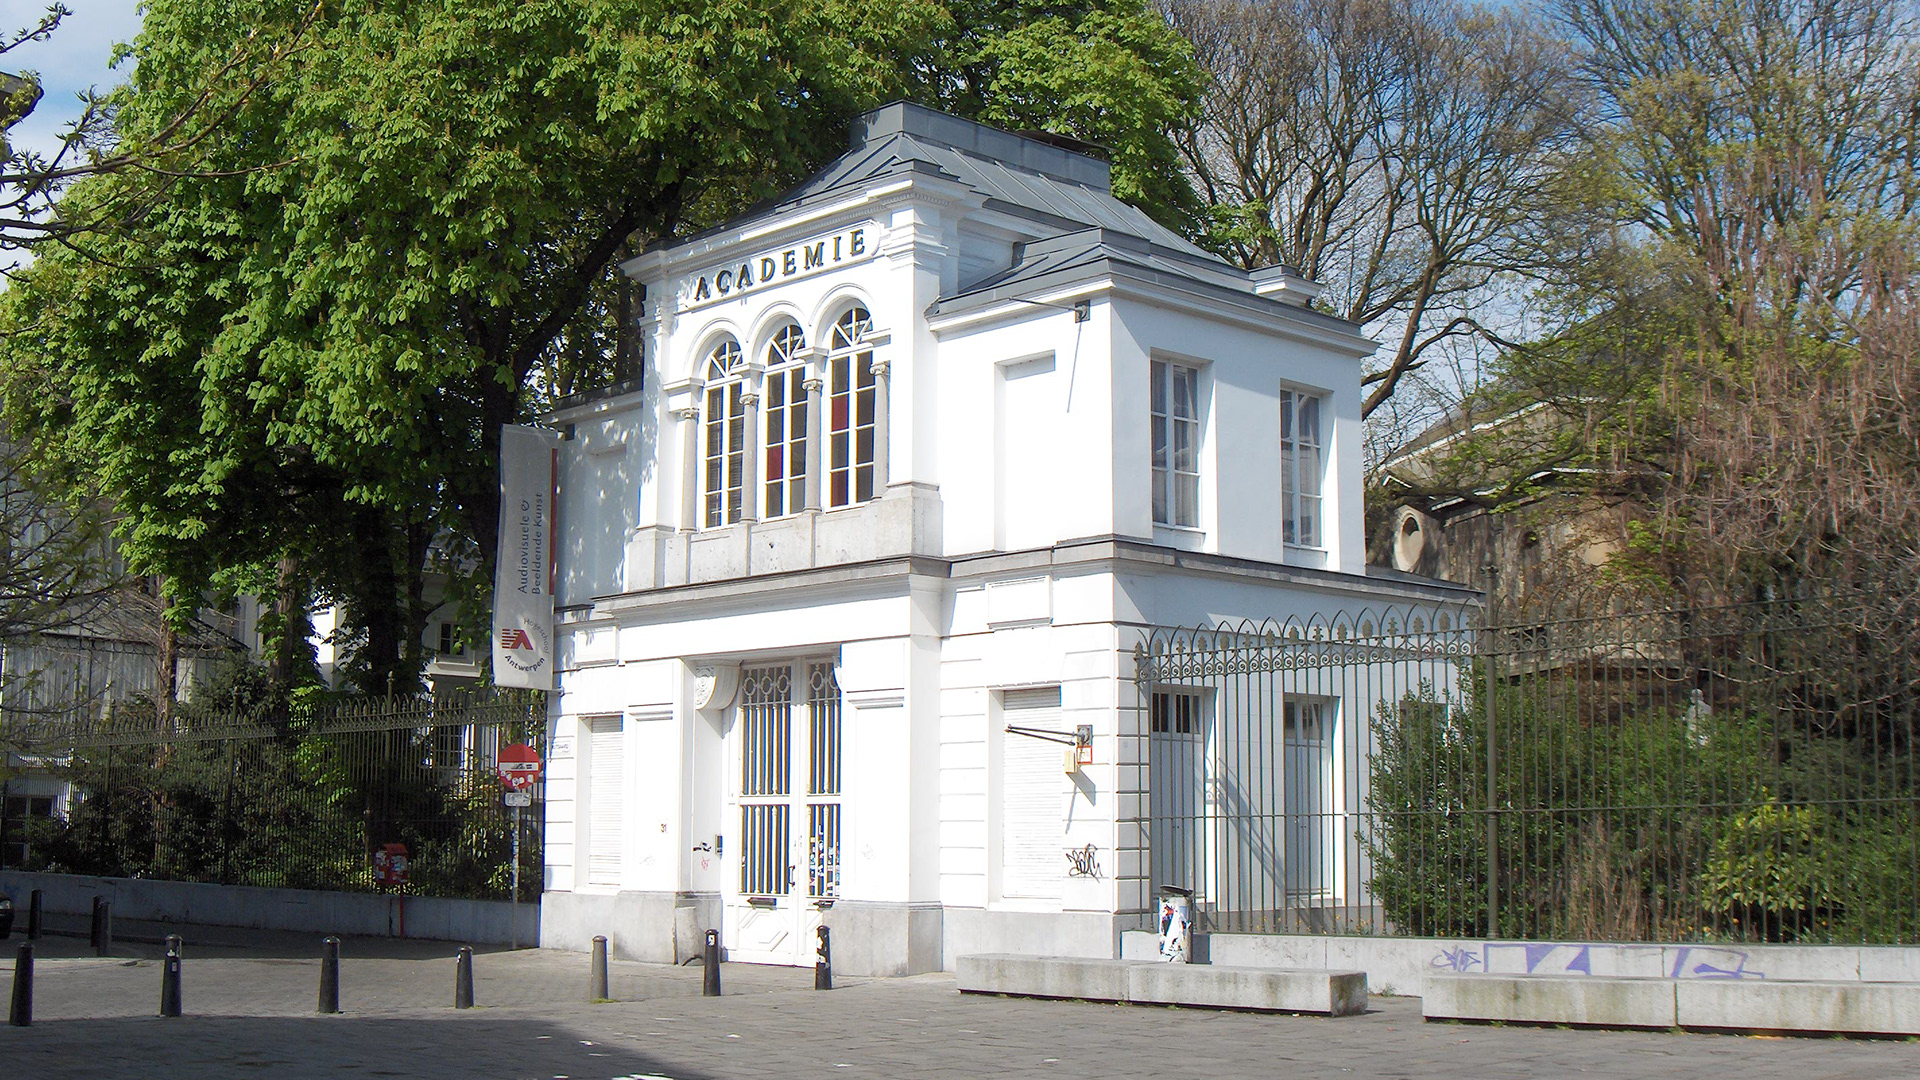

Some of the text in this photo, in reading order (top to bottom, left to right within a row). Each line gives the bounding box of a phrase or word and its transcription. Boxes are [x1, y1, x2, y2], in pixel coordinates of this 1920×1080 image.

[694, 229, 866, 301] ACADEMIE
[517, 515, 530, 595] Audiovisuele
[531, 493, 543, 595] Beeldende Kunst
[504, 655, 546, 672] Antwerpen
[523, 618, 549, 654] Hogeschool
